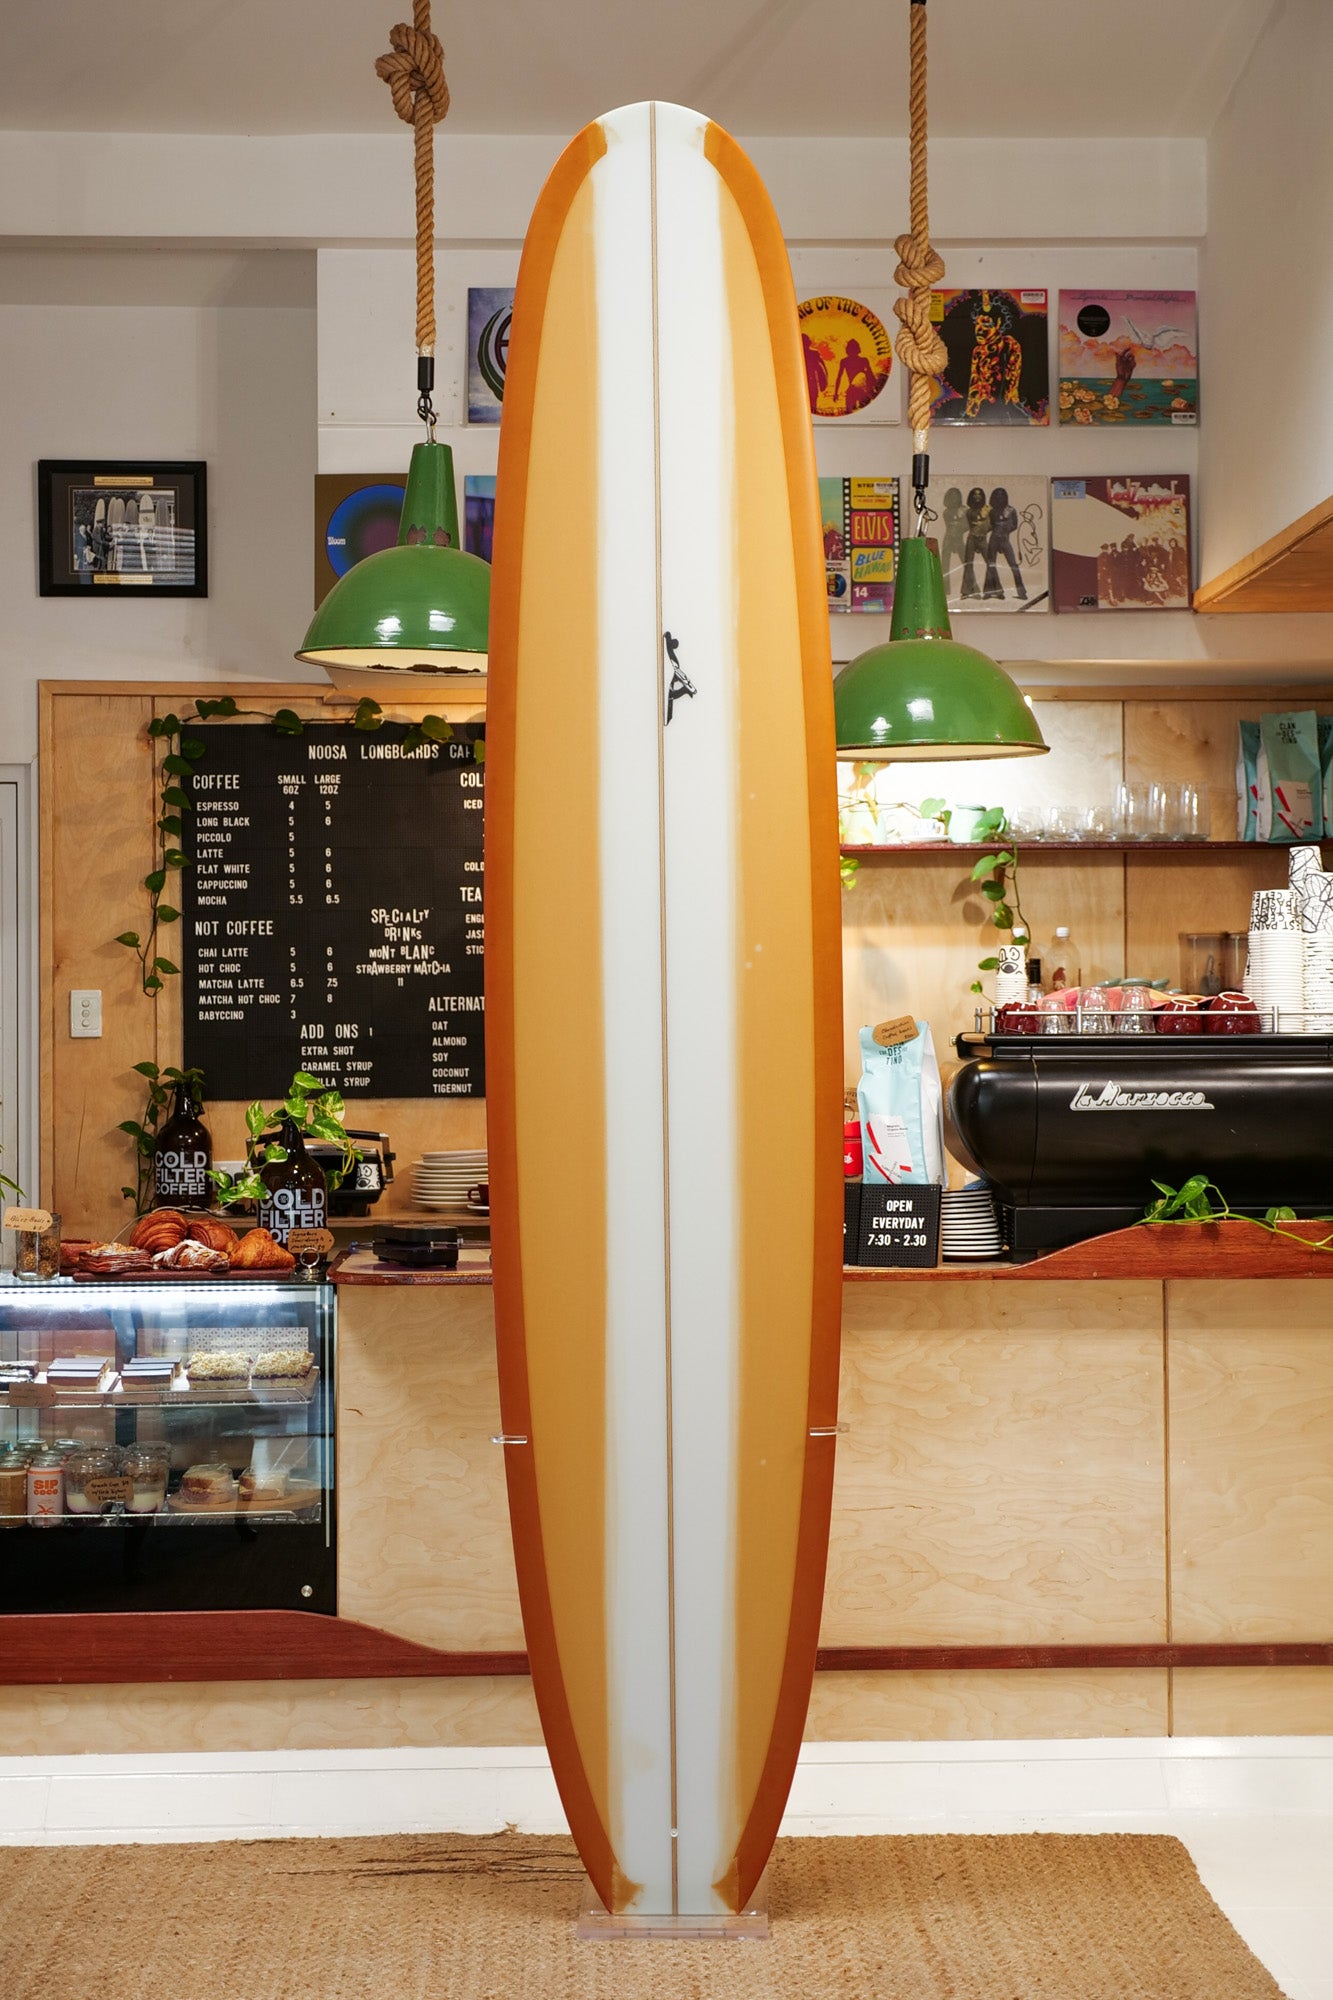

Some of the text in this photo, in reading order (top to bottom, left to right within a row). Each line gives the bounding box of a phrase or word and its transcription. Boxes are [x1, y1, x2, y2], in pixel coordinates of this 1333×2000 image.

[815, 297, 832, 311] OF
[836, 297, 862, 316] THE
[861, 310, 891, 355] EARTH
[854, 515, 891, 541] ELVIS
[855, 550, 886, 566] BLUE
[854, 587, 868, 597] 14
[308, 744, 348, 760] NOOSA
[192, 774, 240, 790] COFFEE
[277, 774, 341, 785] SMALL LARGE
[459, 772, 484, 789] COL
[196, 800, 331, 812] ESPRESSO 4 5
[463, 798, 484, 810] ICED
[196, 816, 332, 827] LONG BLACK 5 6
[196, 831, 295, 843] PICCOLO 5
[196, 847, 332, 859] LATTE 5 6
[197, 863, 332, 874] FLAT WHITE 5 6
[197, 878, 332, 890] CAPPUCCINO 5 6
[197, 894, 340, 906] MOCHA 5.5 6.5
[459, 886, 483, 903] TEA
[370, 908, 430, 927] SPECIALTY
[195, 920, 274, 936] NOT COFFEE
[384, 926, 422, 942] DRINKS
[198, 946, 333, 958] CHAI LATTE 5 6
[368, 944, 435, 960] MONT BLANC
[198, 962, 334, 973] HOT CHOC 5 6
[355, 960, 451, 976] STRAWBERRY MATCHA
[198, 979, 234, 989] MATCHA
[237, 978, 265, 989] LATTE
[290, 978, 304, 988] 6.5
[198, 993, 333, 1005] MATCHA HOT CHOC 7 8
[198, 1009, 297, 1021] BABYCCINO 3
[300, 1023, 324, 1039] ADD
[335, 1023, 359, 1039] ONS
[431, 1020, 449, 1031] OAT
[432, 1036, 467, 1047] ALMOND
[301, 1045, 355, 1056] EXTRA SHOT
[432, 1052, 449, 1062] SOY
[301, 1061, 373, 1072] CARAMEL SYRUP
[432, 1067, 470, 1078] COCONUT
[343, 1077, 371, 1087] SYRUP
[432, 1083, 472, 1094] TIGERNUT
[1070, 1080, 1208, 1109] La Marzocco
[155, 1150, 207, 1168] COLD
[155, 1168, 206, 1182] FILTER
[155, 1183, 206, 1195] COFFEE
[260, 1188, 325, 1210] COLD
[886, 1200, 913, 1212] OPEN
[260, 1209, 325, 1229] FILTER
[872, 1217, 925, 1229] EVERYDAY
[867, 1234, 891, 1246] 7:30
[903, 1234, 927, 1246] 2.30
[33, 1479, 59, 1490] SIP
